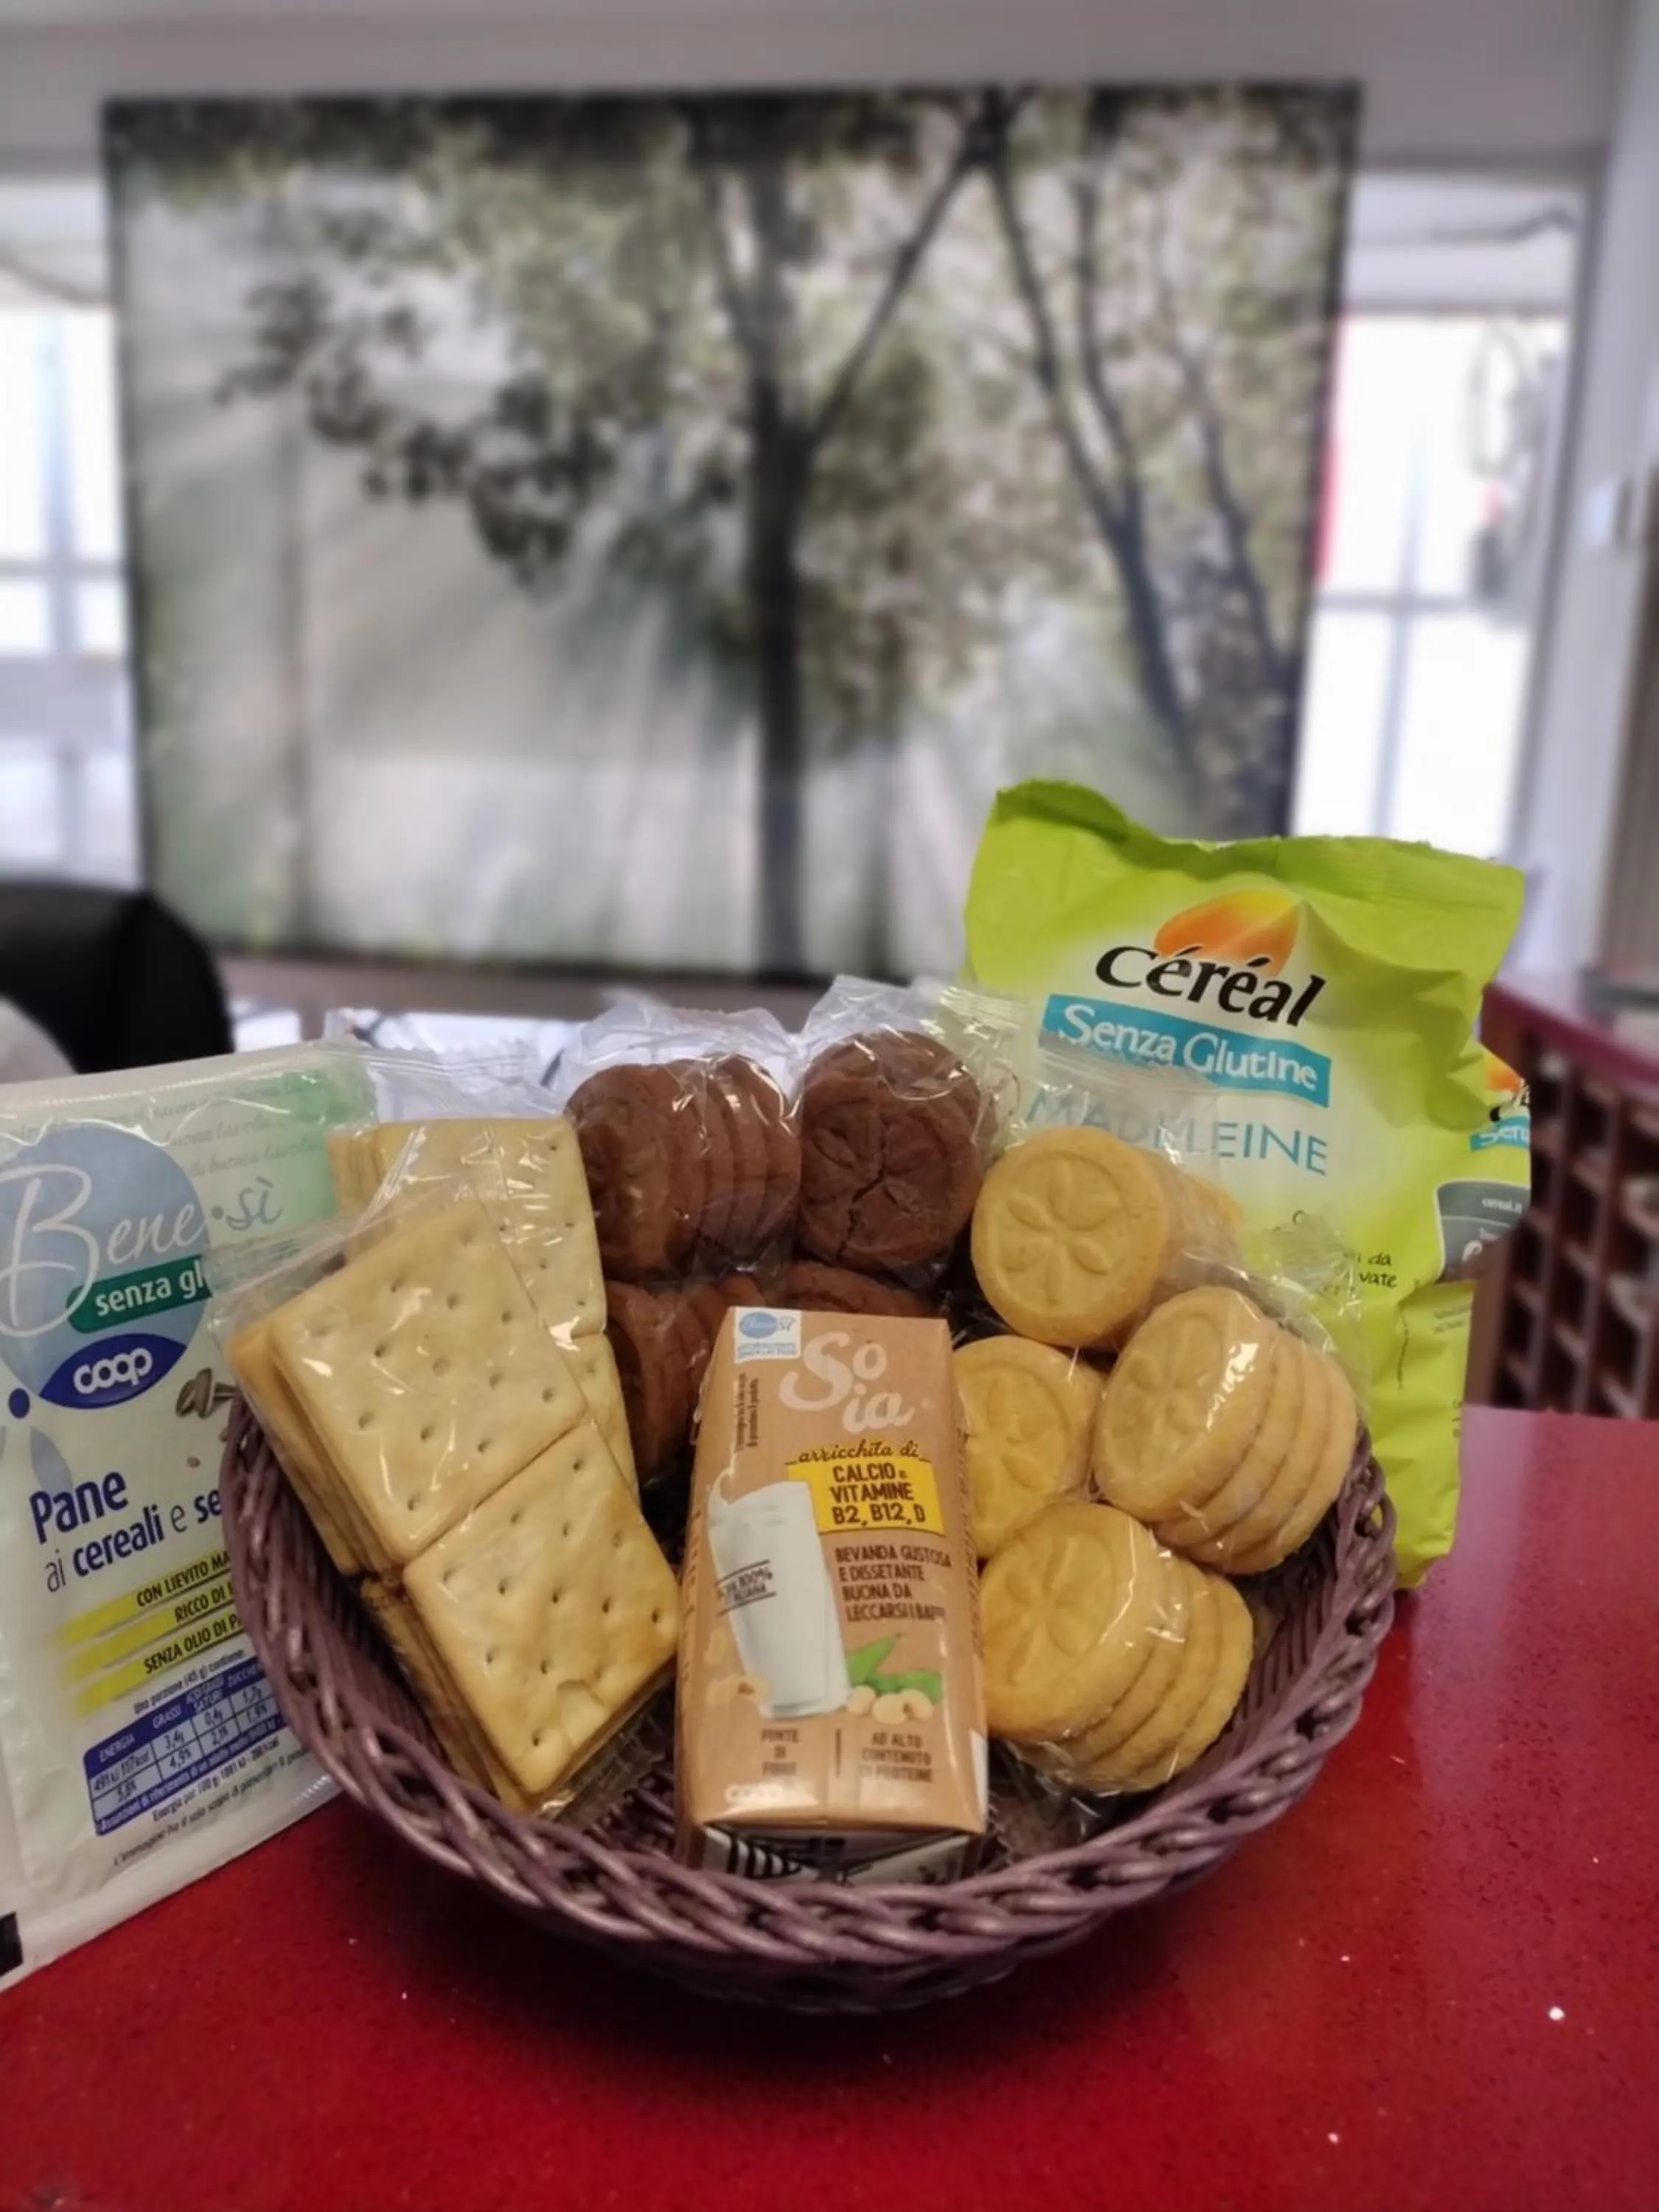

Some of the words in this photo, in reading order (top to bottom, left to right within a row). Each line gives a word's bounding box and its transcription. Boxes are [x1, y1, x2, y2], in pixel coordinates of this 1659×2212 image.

[1095, 945, 1326, 1027] Céréal
[1057, 1003, 1176, 1066] Senza
[1183, 1032, 1318, 1092] Glutine
[0, 1164, 206, 1337] Bene
[1367, 1252, 1392, 1266] da
[95, 1277, 172, 1316] senza
[73, 1347, 153, 1395] coop
[799, 1439, 894, 1463] arricchita
[900, 1440, 919, 1458] di
[832, 1462, 896, 1483] CALCIO
[29, 1472, 128, 1545] Pane
[830, 1482, 914, 1503] VITAMINE
[831, 1505, 868, 1527] B2,
[869, 1502, 911, 1525] B12,
[913, 1503, 926, 1523] D
[45, 1548, 66, 1593] ai
[72, 1504, 165, 1577] cereali
[170, 1505, 187, 1533] e
[835, 1545, 898, 1563] BEVANDA
[900, 1545, 953, 1568] GUSTOSA
[136, 1583, 163, 1607] CON
[164, 1561, 209, 1593] LIEVITO
[838, 1566, 848, 1582] E
[849, 1563, 925, 1582] DISSETANTE
[174, 1594, 209, 1623] RICCO
[211, 1585, 226, 1604] DI
[841, 1583, 891, 1602] BUONA
[891, 1582, 913, 1599] DA
[846, 1602, 908, 1622] LECCARSI
[144, 1644, 183, 1674] SENZA
[184, 1627, 211, 1652] OLIO
[212, 1619, 227, 1638] DI
